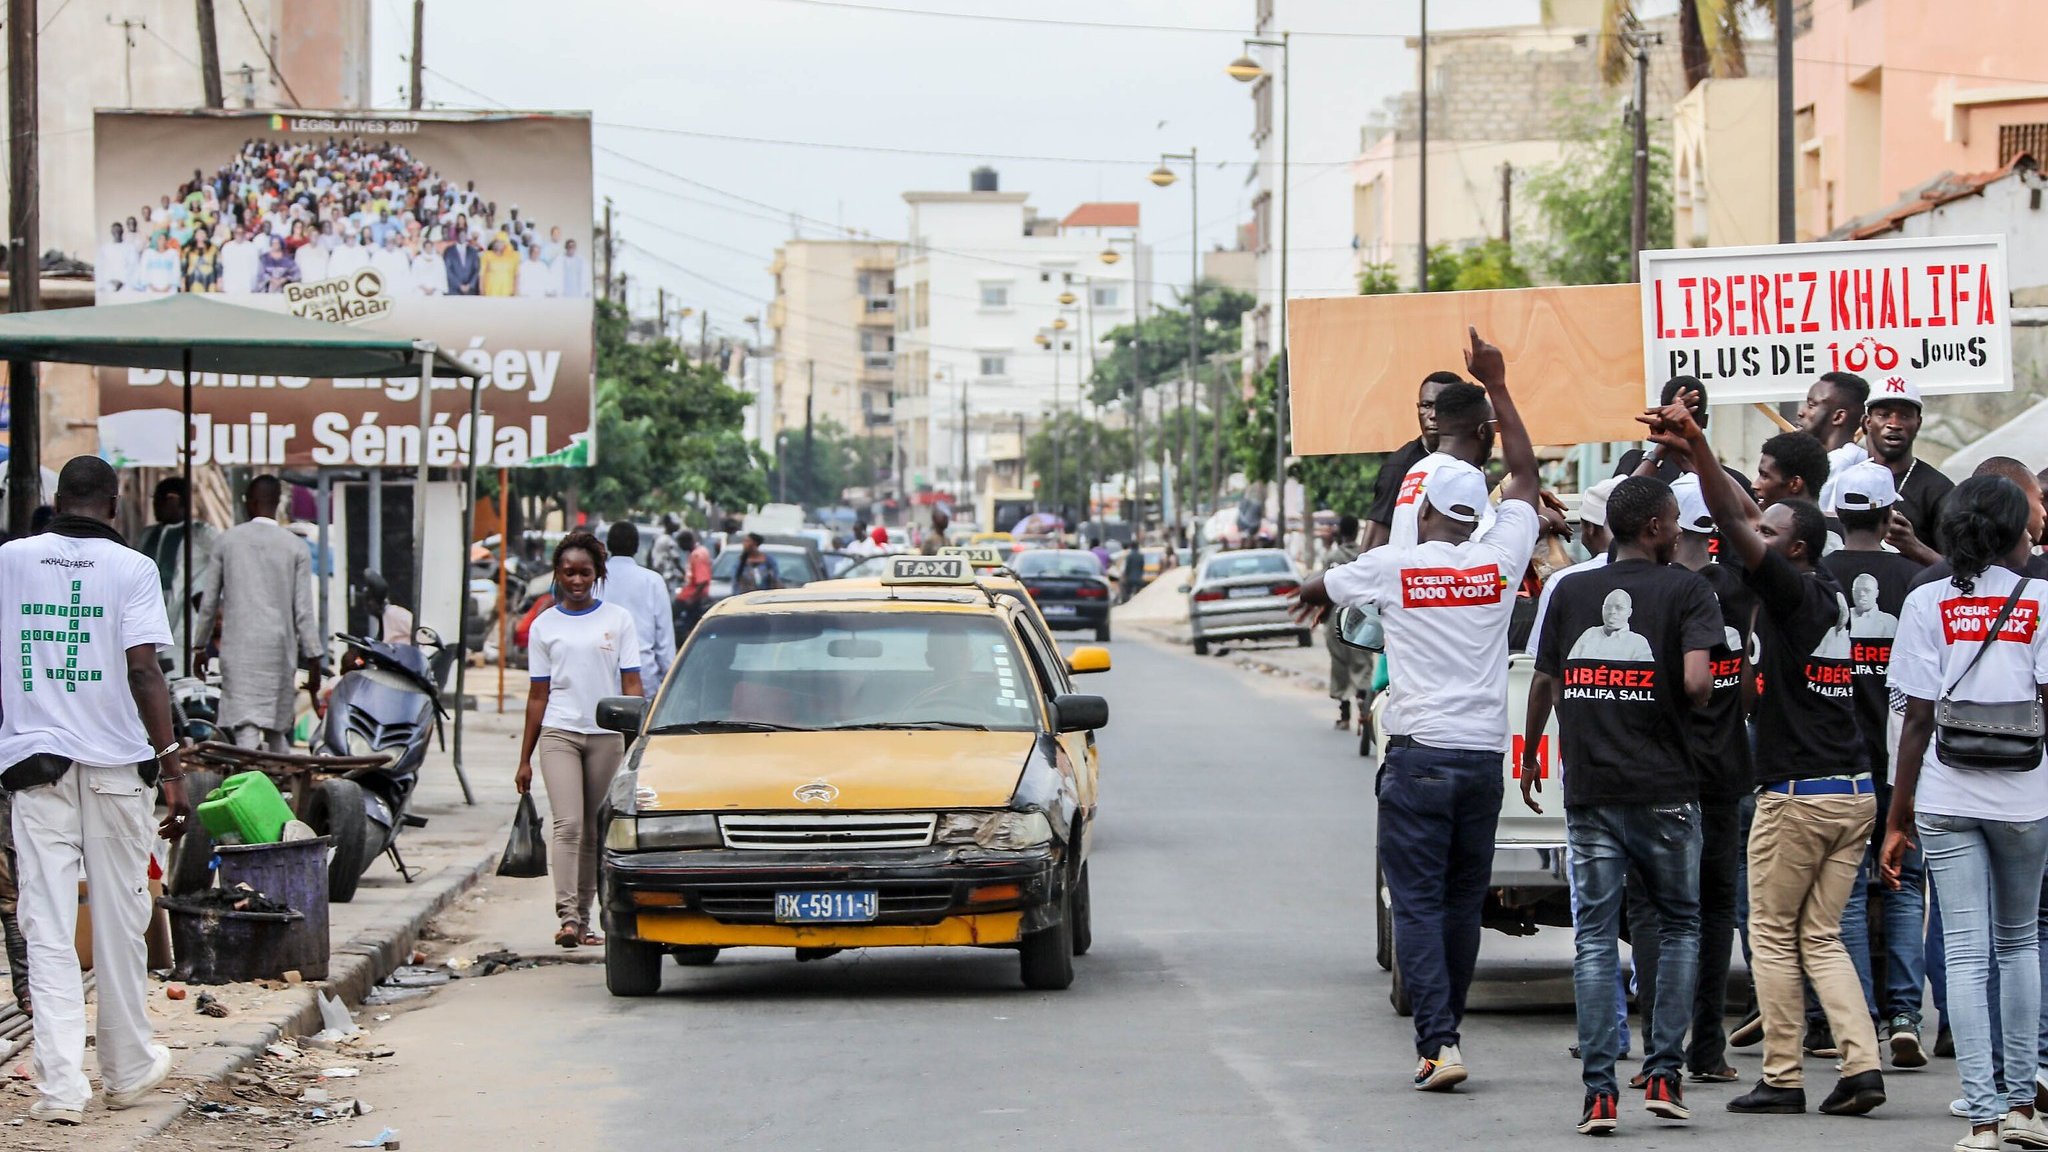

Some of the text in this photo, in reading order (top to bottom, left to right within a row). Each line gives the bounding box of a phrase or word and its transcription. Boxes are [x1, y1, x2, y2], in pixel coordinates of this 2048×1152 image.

[388, 121, 419, 134] 2017
[288, 279, 350, 303] Benno
[1655, 263, 1995, 339] LIBEREZ KHALIFA
[1669, 345, 1761, 380] PLUS
[1771, 342, 1816, 376] DE
[1826, 341, 1899, 374] 100
[311, 410, 548, 467] Sénégal
[897, 561, 958, 577] TAXI
[1405, 576, 1412, 586] 1
[1407, 584, 1497, 600] 1000 VOIX
[22, 603, 104, 618] CULTURE
[1945, 608, 1952, 619] 1
[22, 629, 91, 643] SOCIAL
[22, 630, 33, 692] SANTE
[1564, 664, 1656, 688] LIBÉREZ
[1713, 675, 1740, 689] SALL
[1804, 664, 1852, 684] LIBÉR
[1619, 689, 1656, 702] SALL
[778, 893, 876, 918] DK-5911-U
